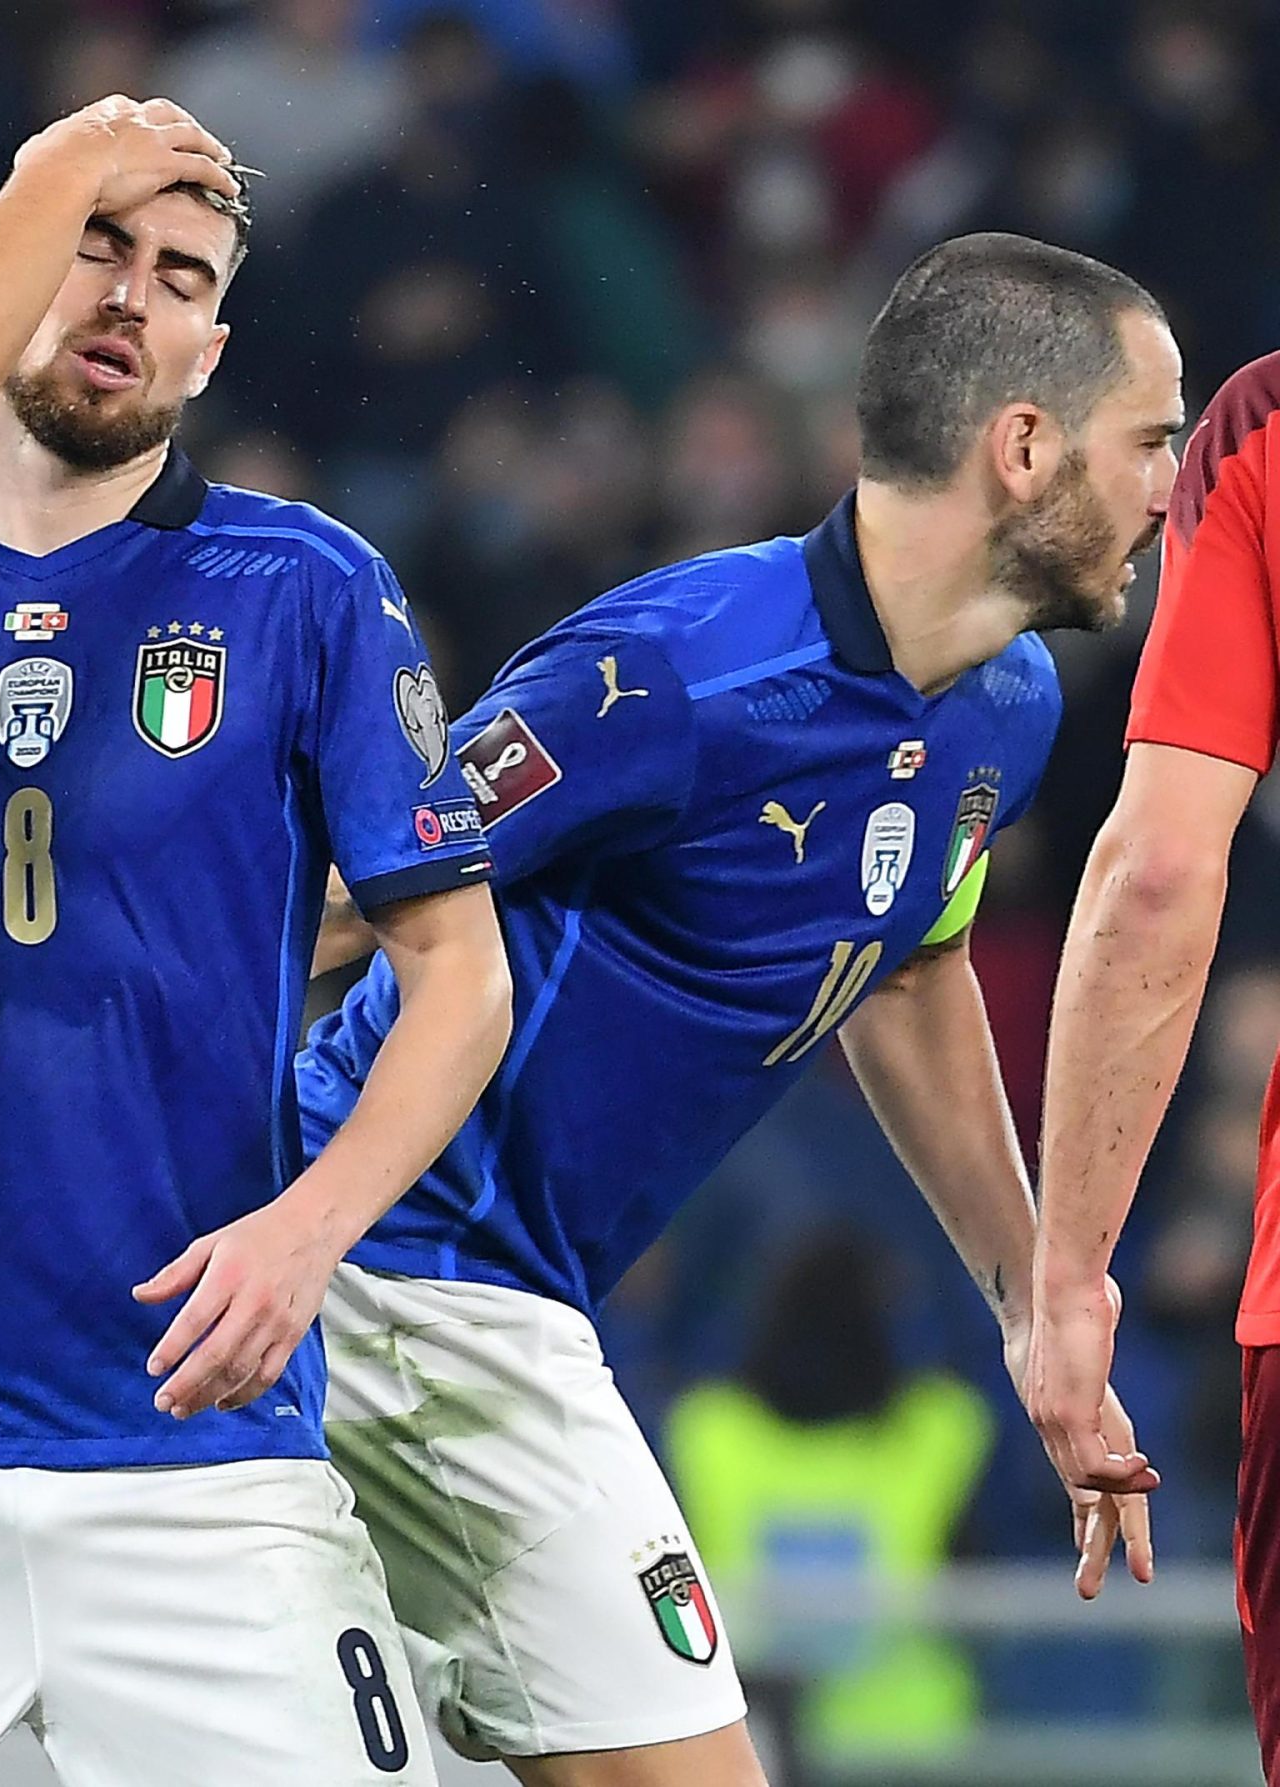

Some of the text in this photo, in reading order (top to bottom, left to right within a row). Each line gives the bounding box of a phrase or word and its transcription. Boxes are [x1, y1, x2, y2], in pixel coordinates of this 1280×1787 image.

[7, 688, 60, 697] CHAMPIONS
[8, 679, 61, 688] EUROPEAN
[146, 651, 217, 669] ITALIA
[4, 787, 57, 945] 8
[762, 941, 883, 1066] 19
[337, 1628, 409, 1773] 8
